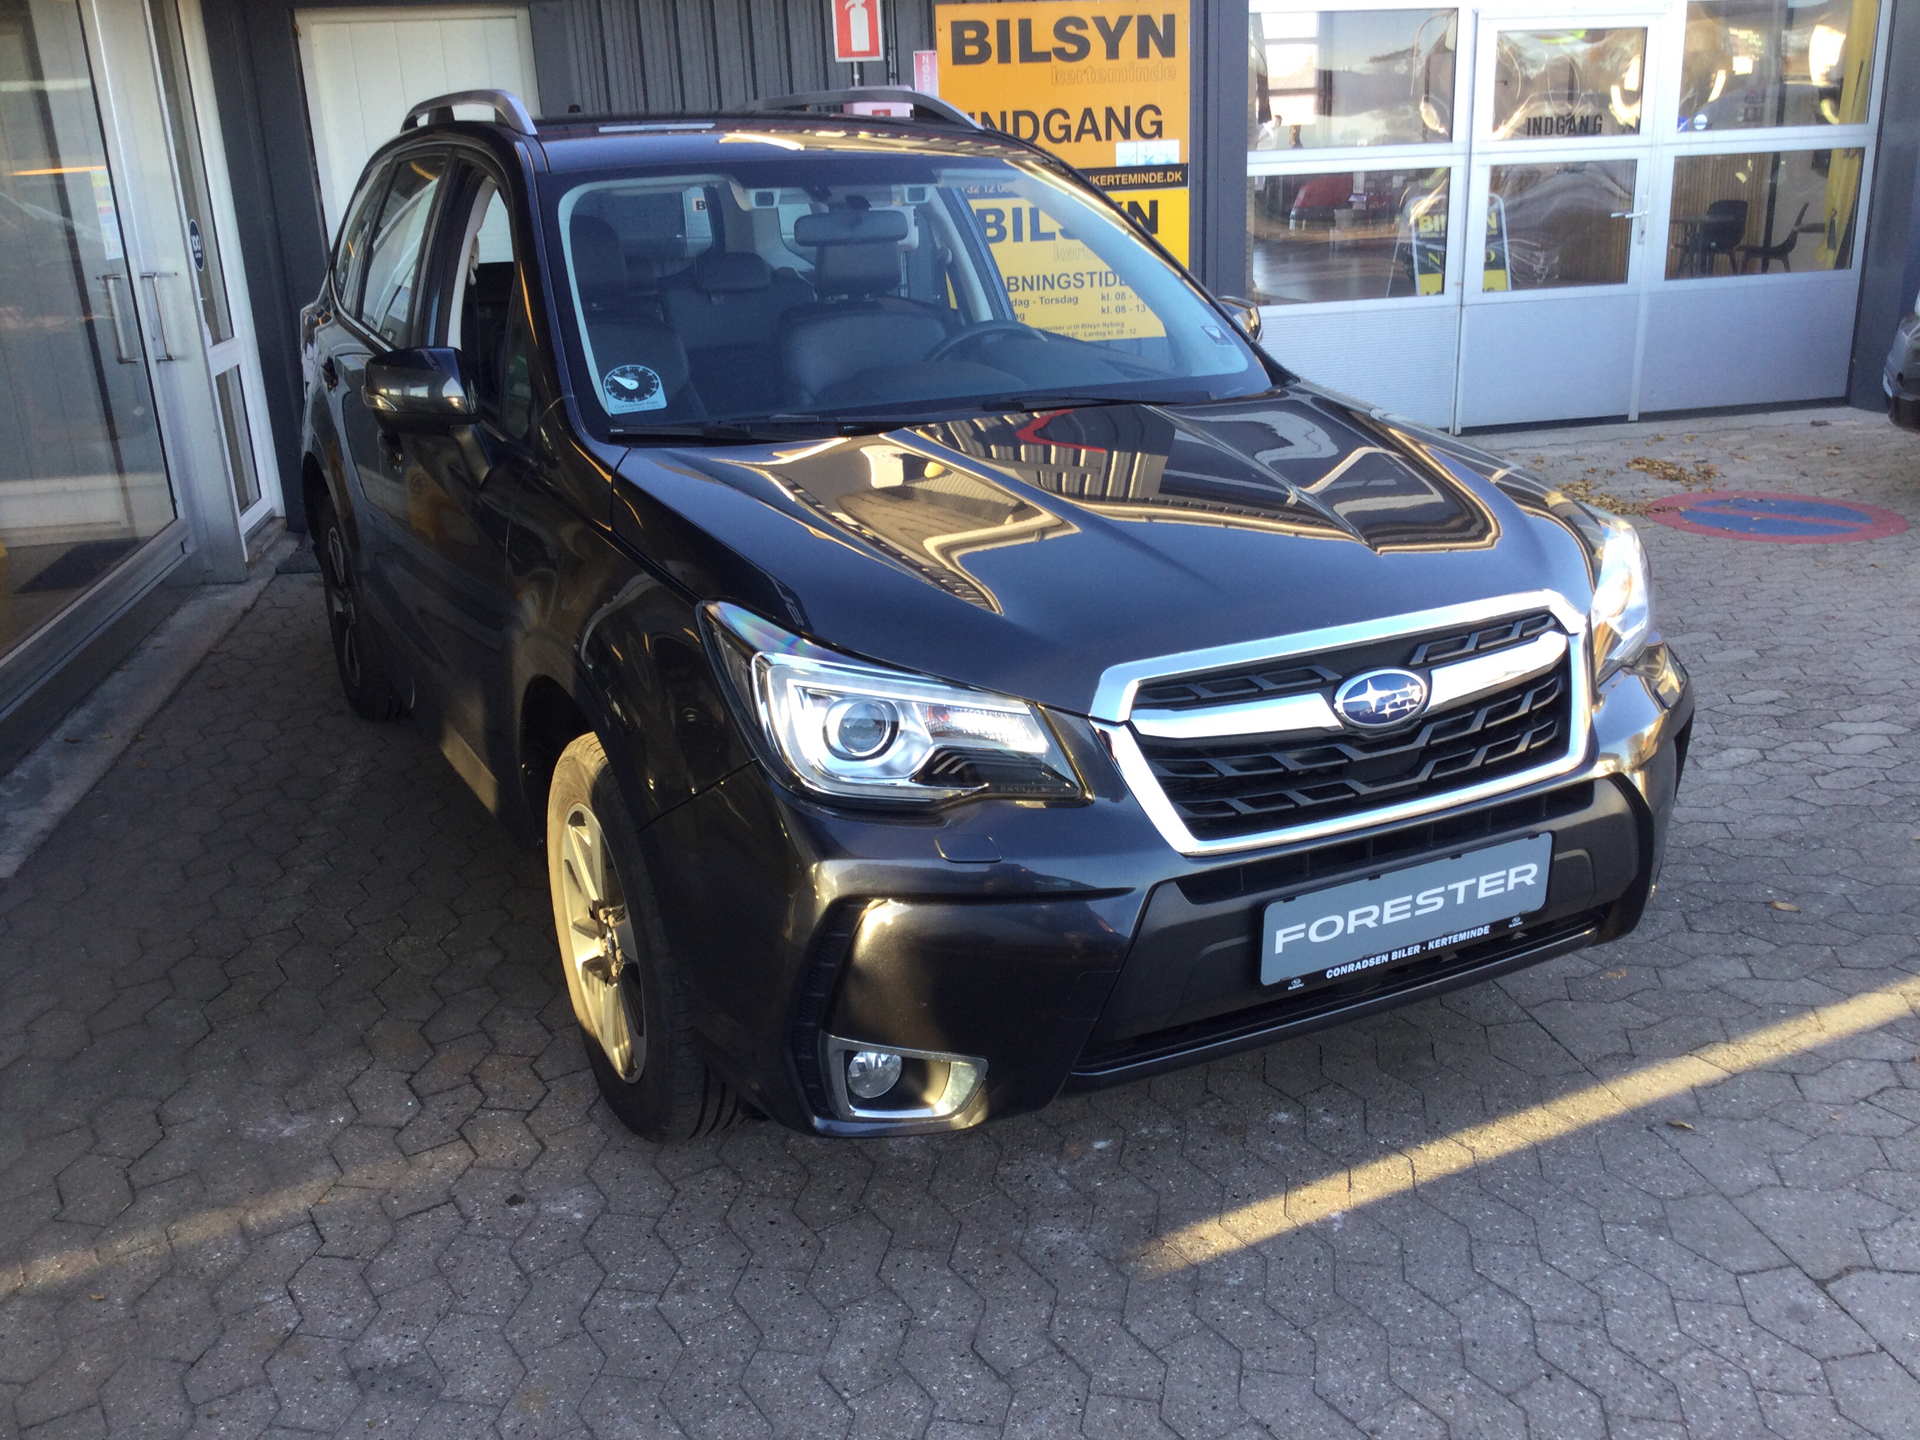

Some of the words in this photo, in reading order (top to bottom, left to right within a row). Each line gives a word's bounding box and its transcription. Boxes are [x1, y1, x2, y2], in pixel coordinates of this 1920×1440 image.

[951, 14, 1176, 65] BILSYN
[1050, 62, 1176, 85] kerteminde
[1527, 114, 1603, 136] INDGANG
[1090, 171, 1182, 186] KERTEMINDE.DK
[1040, 295, 1079, 305] Torsdag
[1101, 292, 1112, 301] kl.
[1115, 292, 1126, 301] 08
[1101, 305, 1112, 314] kl.
[1115, 305, 1126, 314] 08
[1136, 304, 1146, 313] 13
[1081, 322, 1101, 330] Bilsyn
[1102, 321, 1125, 329] Nyborg
[1274, 863, 1538, 954] FORESTER
[1326, 953, 1389, 979] CONRADSEN
[1391, 944, 1421, 961] BILER
[1427, 925, 1491, 950] KERTEMINDE
